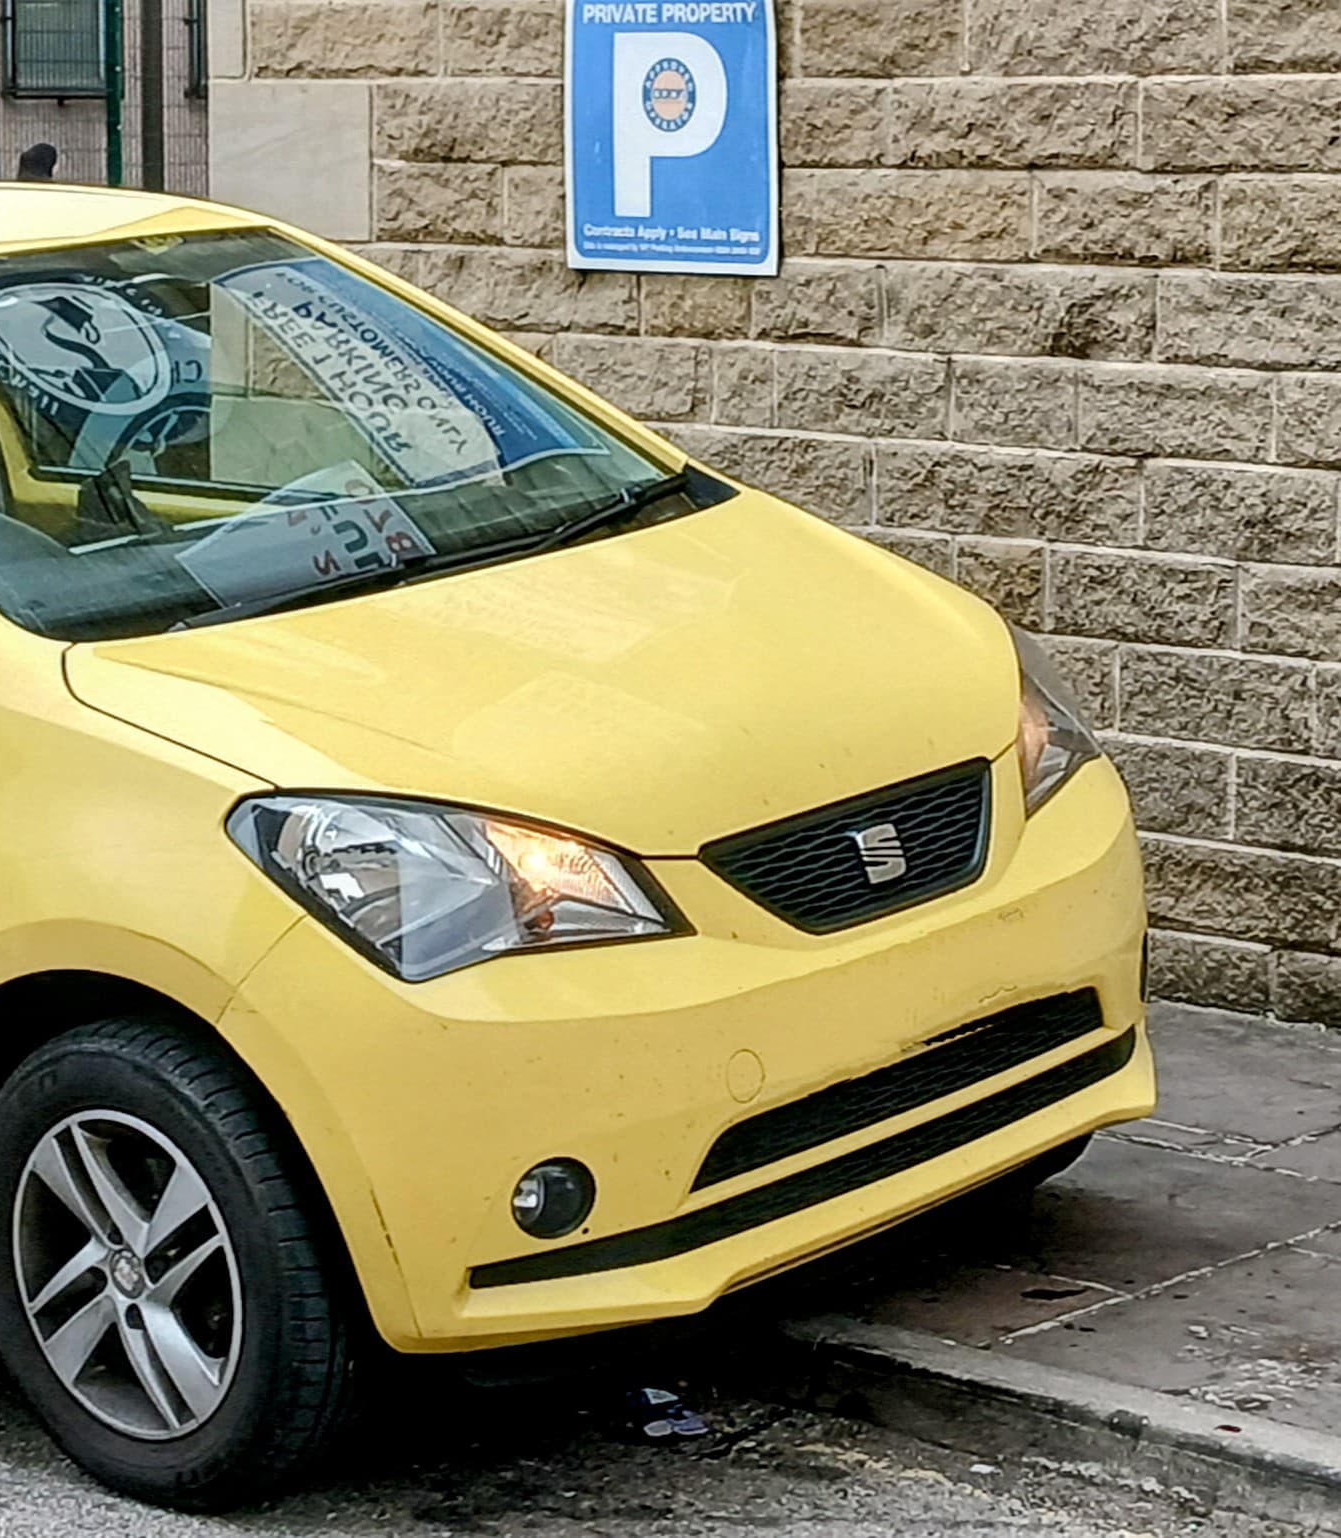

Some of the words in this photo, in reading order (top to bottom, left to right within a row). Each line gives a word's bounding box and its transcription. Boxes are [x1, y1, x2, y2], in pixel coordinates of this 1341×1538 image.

[583, 3, 657, 24] PRIVATE
[662, 2, 758, 24] PROPERTY
[613, 32, 727, 218] P
[637, 224, 667, 241] Apply
[676, 226, 698, 240] See
[700, 226, 727, 241] Main
[729, 228, 760, 244] Signs
